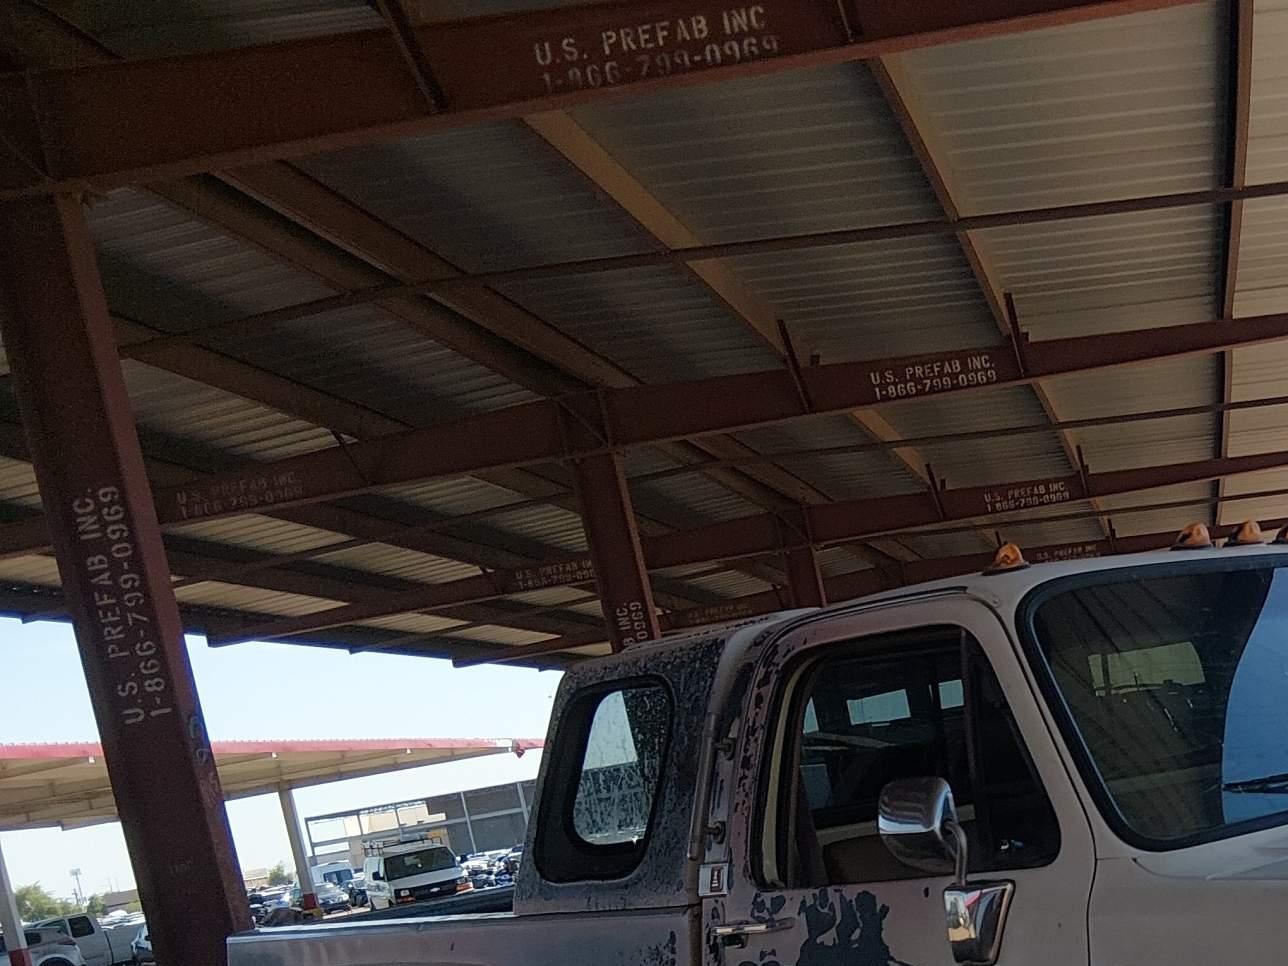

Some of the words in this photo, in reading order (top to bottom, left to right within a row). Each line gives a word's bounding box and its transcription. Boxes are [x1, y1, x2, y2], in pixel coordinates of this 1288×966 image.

[534, 36, 588, 66] U.S.
[601, 15, 709, 55] PREFAB
[870, 371, 899, 385] U.S.
[905, 359, 961, 379] PREFAB
[967, 355, 996, 369] INC.
[874, 369, 997, 400] 1-866-799-0969
[73, 488, 101, 540] INC.
[1008, 484, 1046, 498] PREFAB
[87, 554, 131, 658] PREFAB
[99, 485, 172, 717] 1-866-799-0969
[616, 602, 632, 631] INC.
[117, 672, 145, 724] U.S.
